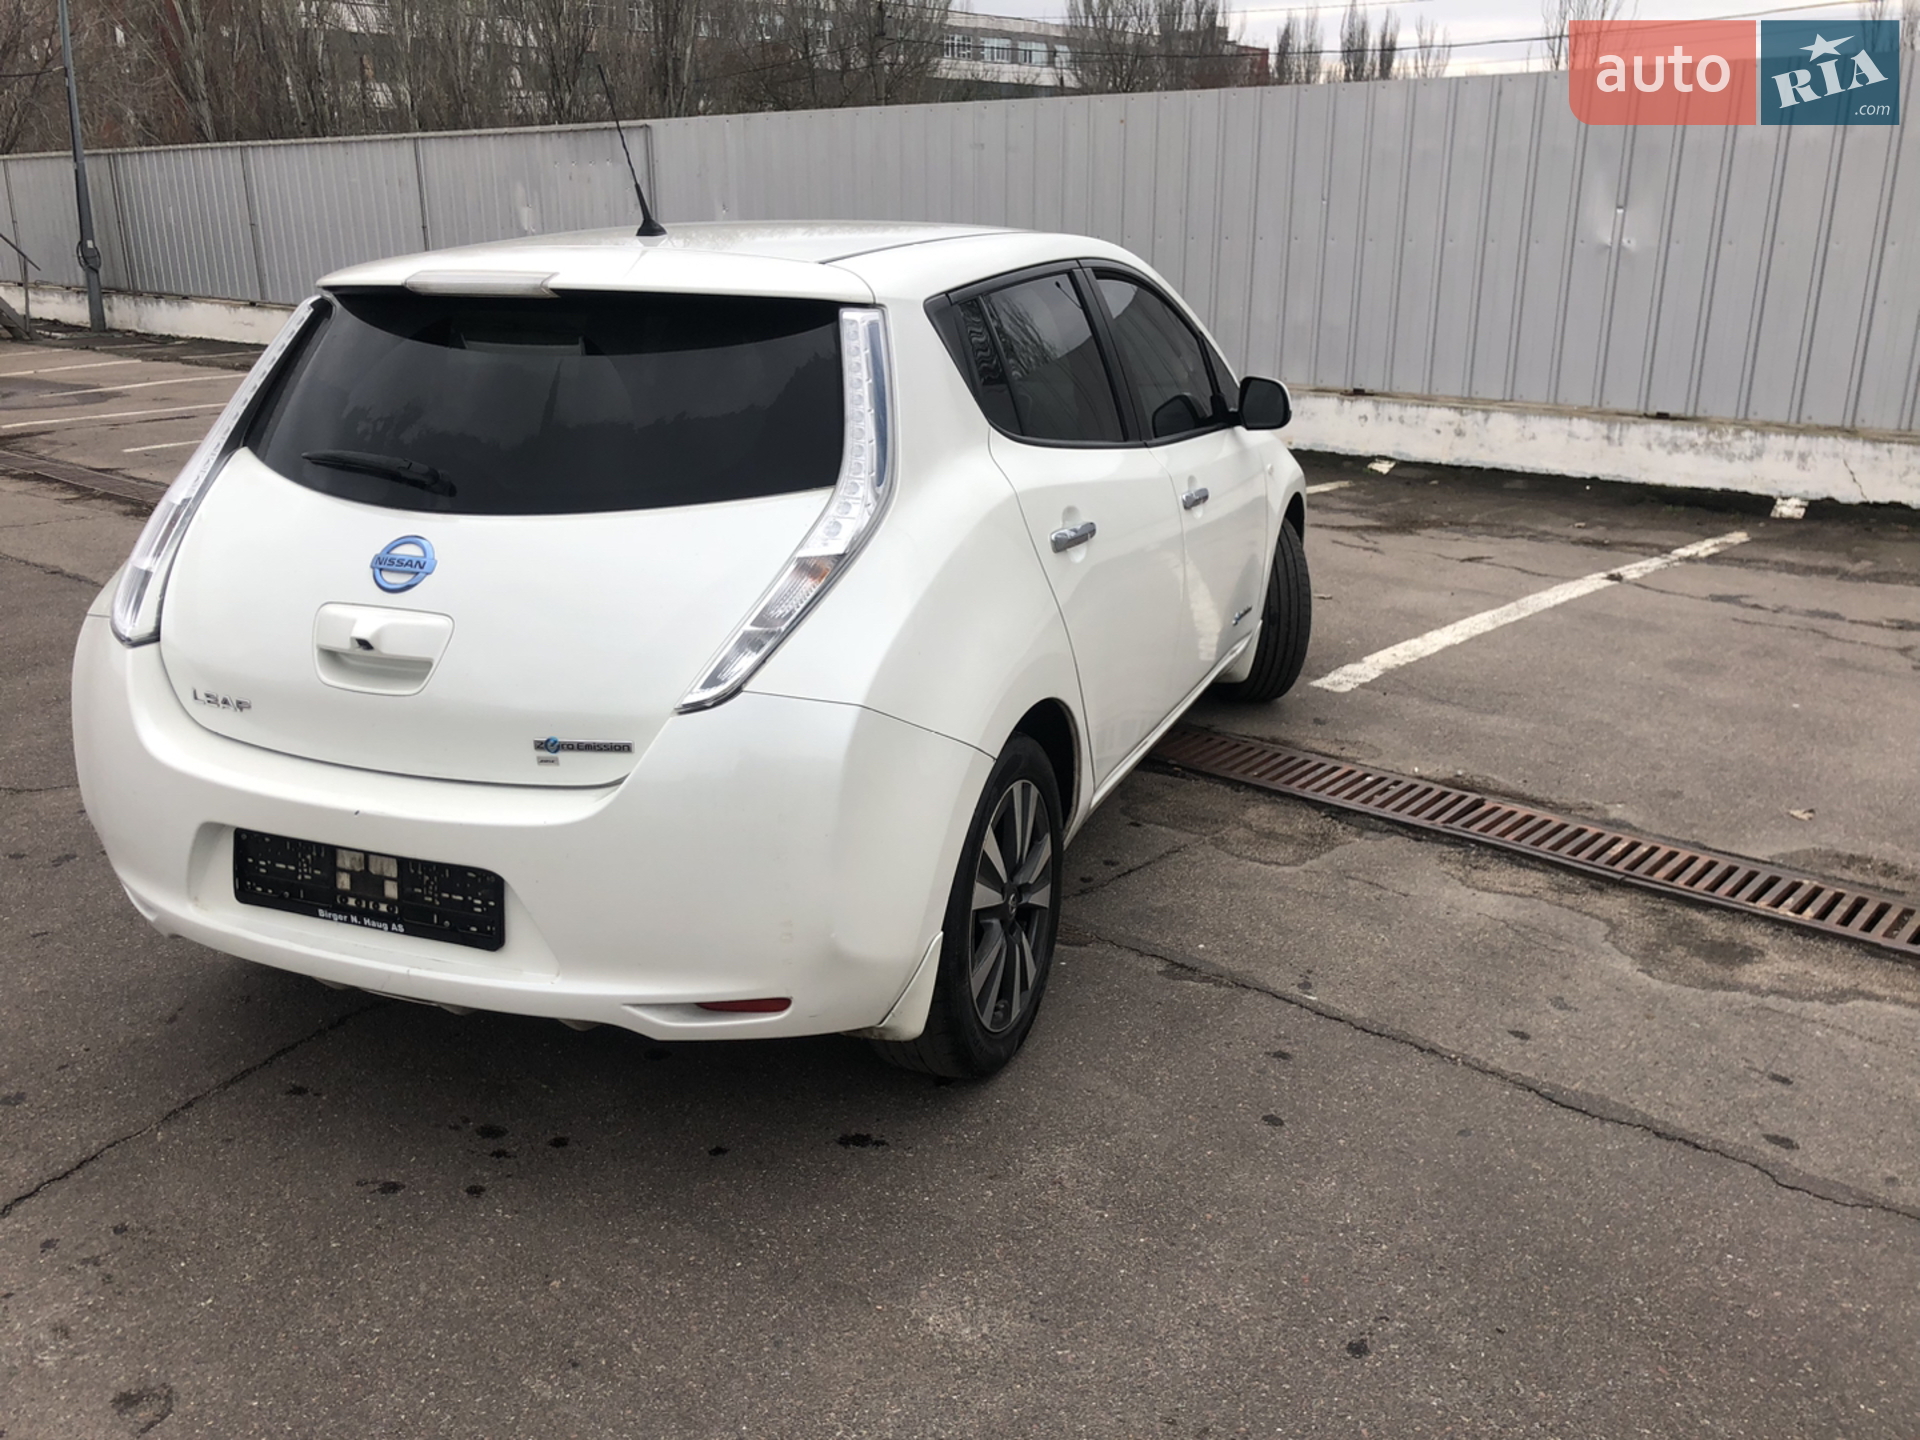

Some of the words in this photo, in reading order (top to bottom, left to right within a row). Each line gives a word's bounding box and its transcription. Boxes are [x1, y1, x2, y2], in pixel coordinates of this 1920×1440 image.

[375, 557, 427, 569] NISSAN
[577, 742, 630, 752] Emission
[318, 909, 347, 921] Birger
[363, 917, 389, 931] Haug
[391, 923, 405, 933] AS
